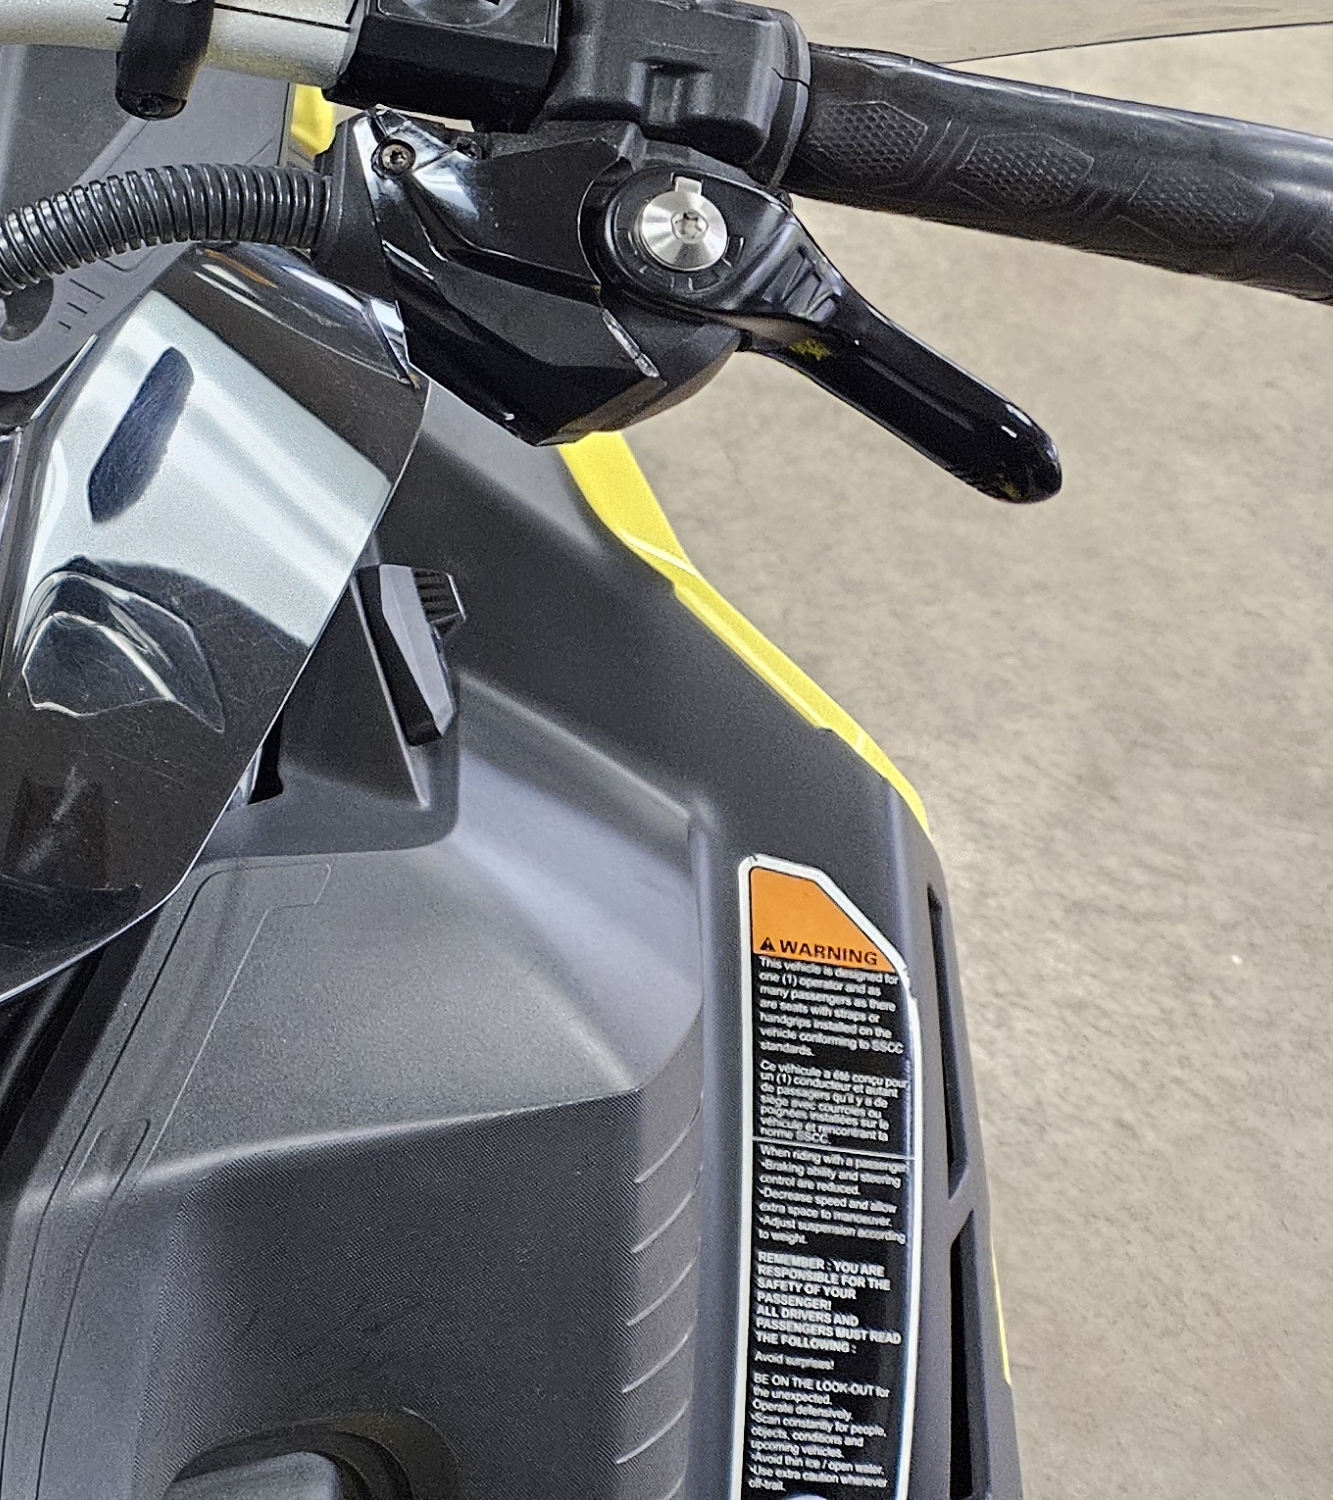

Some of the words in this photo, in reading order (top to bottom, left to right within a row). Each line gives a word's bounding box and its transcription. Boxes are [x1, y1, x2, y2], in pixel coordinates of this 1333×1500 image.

[759, 956, 781, 968] This
[780, 938, 876, 965] WARNING
[759, 984, 787, 999] many
[845, 982, 865, 994] and
[758, 1251, 824, 1269] REMEMBER
[833, 1260, 858, 1273] YOU
[860, 1263, 884, 1277] ARE
[757, 1264, 838, 1284] RESPONSIBLE
[841, 1274, 865, 1288] FOR
[868, 1277, 890, 1291] THE
[757, 1277, 802, 1293] SAFETY
[804, 1283, 820, 1295] OF
[824, 1285, 856, 1299] YOUR
[756, 1305, 778, 1317] ALL
[781, 1307, 831, 1323] DRIVERS
[833, 1314, 858, 1326] AND
[756, 1317, 832, 1337] PASSENGERS
[835, 1327, 867, 1341] MUST
[869, 1330, 901, 1344] READ
[756, 1331, 778, 1344] THE
[781, 1334, 849, 1353] FOLLOWING
[753, 1372, 768, 1384] BE
[771, 1374, 789, 1387] ON
[792, 1377, 813, 1390] THE
[815, 1379, 874, 1397] LOOK-OUT
